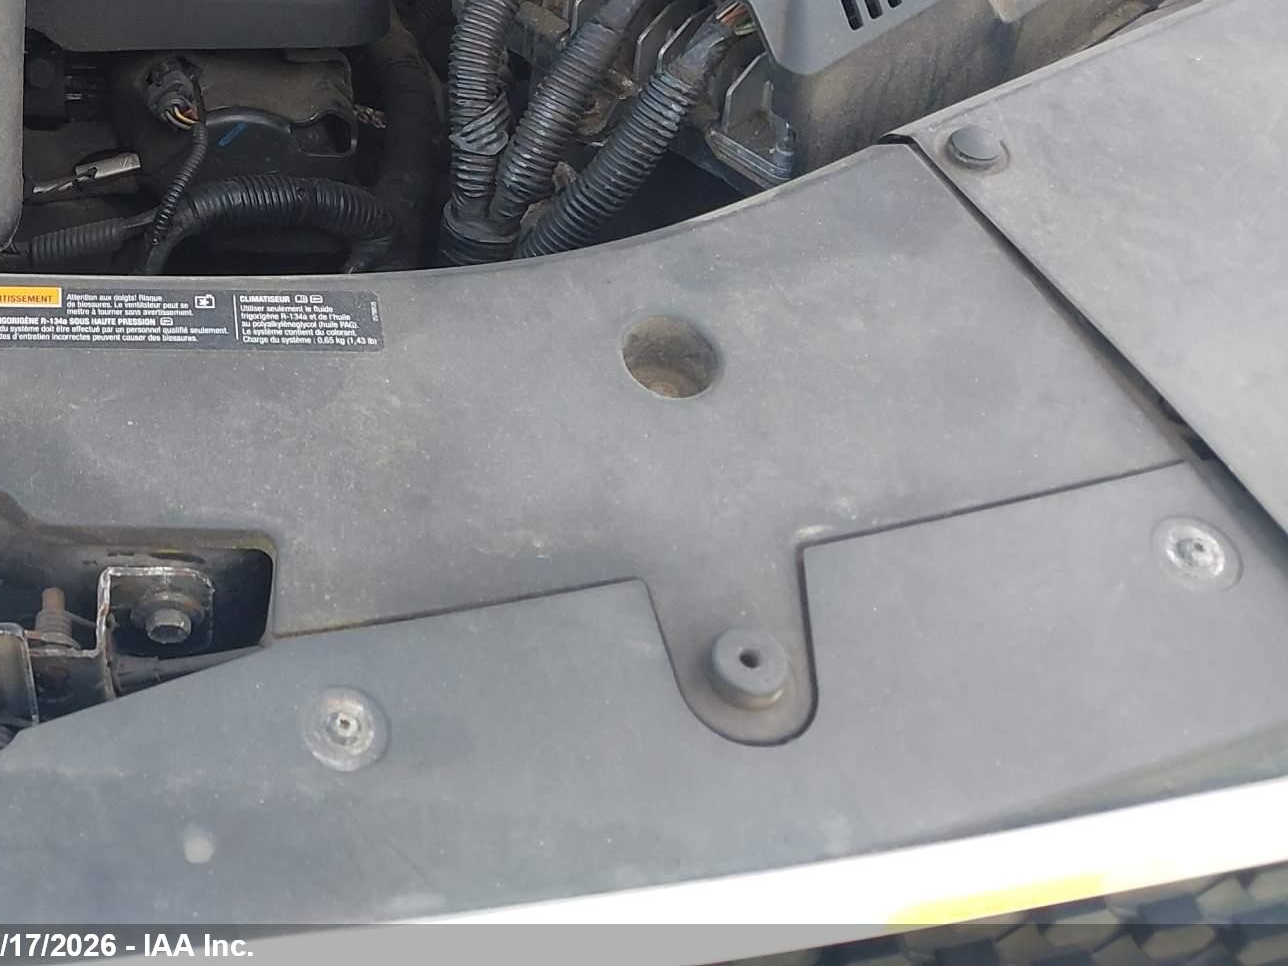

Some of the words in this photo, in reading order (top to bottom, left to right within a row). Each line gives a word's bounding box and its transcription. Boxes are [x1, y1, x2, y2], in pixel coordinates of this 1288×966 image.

[138, 294, 163, 302] Risque
[118, 318, 156, 326] PRESSION
[126, 326, 161, 334] personnel
[242, 336, 269, 344] Charge
[336, 336, 346, 346] kg
